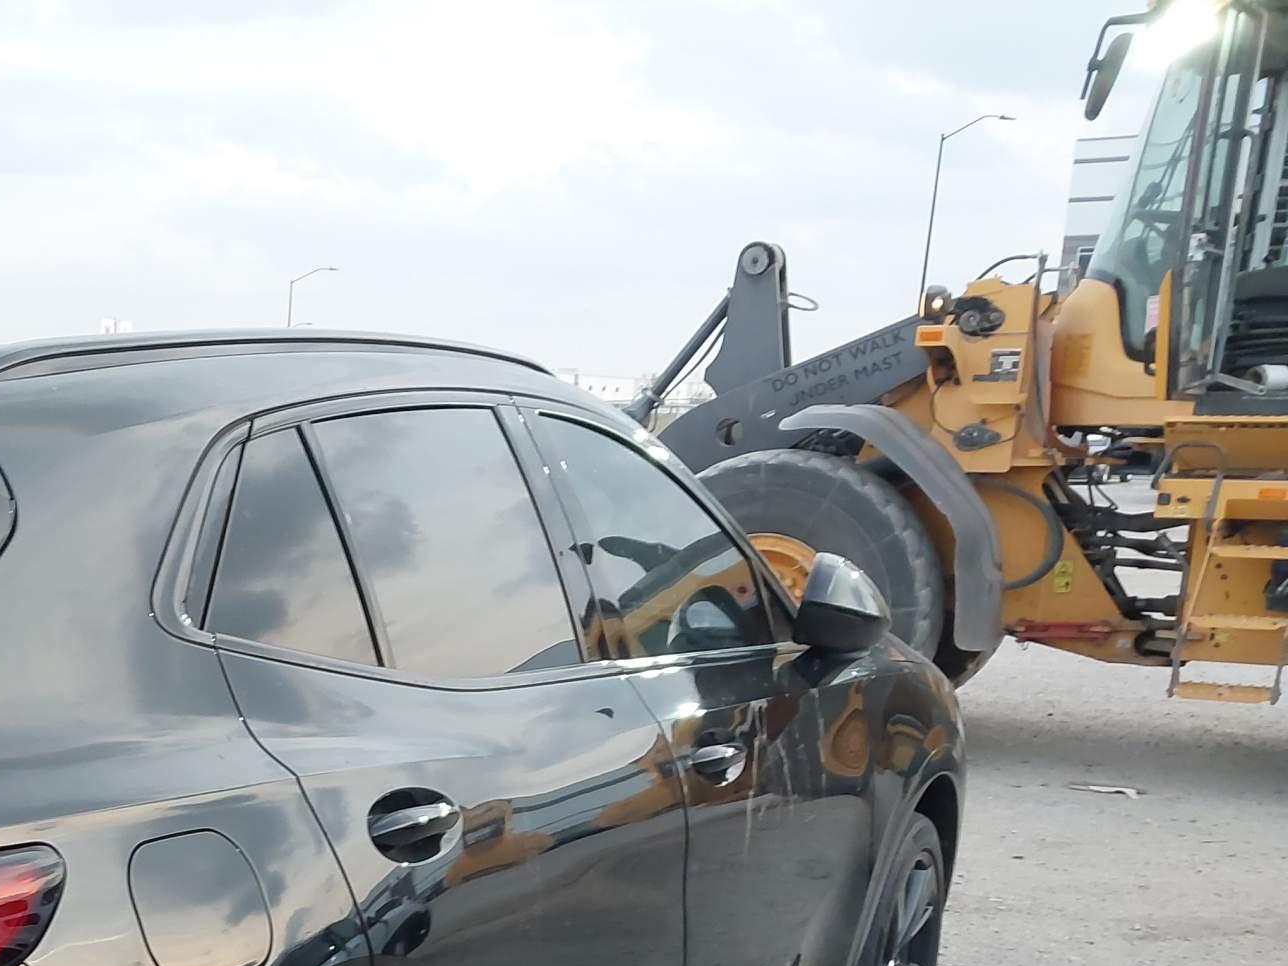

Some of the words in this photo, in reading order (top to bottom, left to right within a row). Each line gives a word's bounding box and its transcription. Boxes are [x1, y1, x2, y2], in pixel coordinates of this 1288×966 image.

[771, 372, 799, 393] DO
[804, 353, 843, 378] NOT
[848, 329, 906, 360] WALK
[854, 352, 903, 380] MAST
